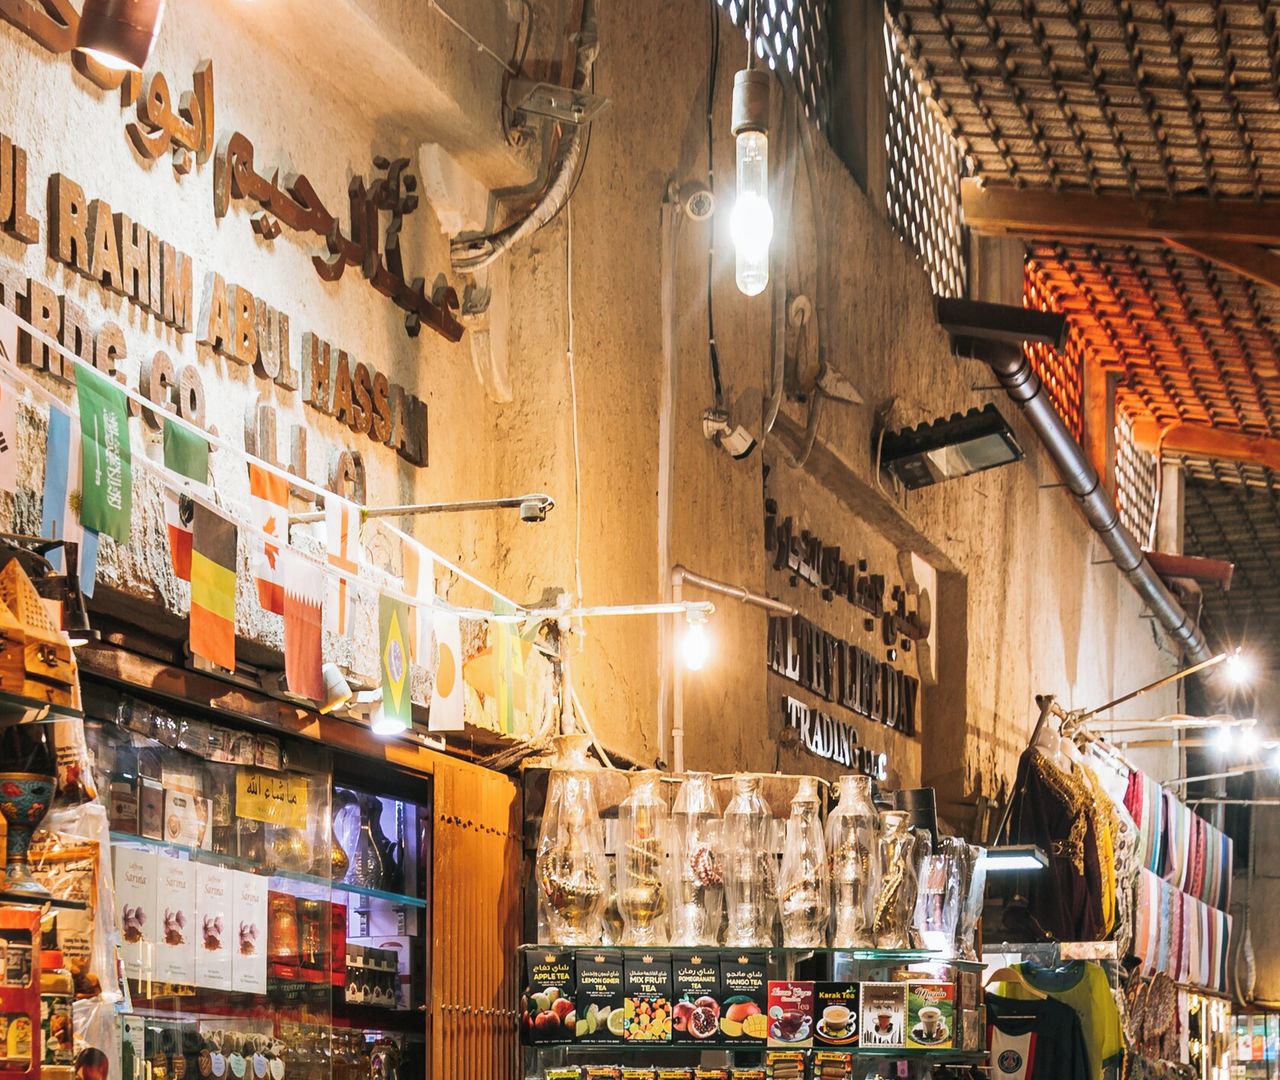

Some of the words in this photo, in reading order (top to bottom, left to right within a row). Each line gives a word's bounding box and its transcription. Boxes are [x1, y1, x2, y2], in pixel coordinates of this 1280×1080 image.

[48, 172, 193, 335] RAHIM
[197, 272, 297, 391] ABUL
[782, 695, 860, 769] TRADING
[859, 747, 887, 781] LLC
[645, 976, 667, 984] FRUIT
[641, 984, 656, 992] TEA
[819, 991, 841, 999] Karak
[842, 991, 855, 999] Tea
